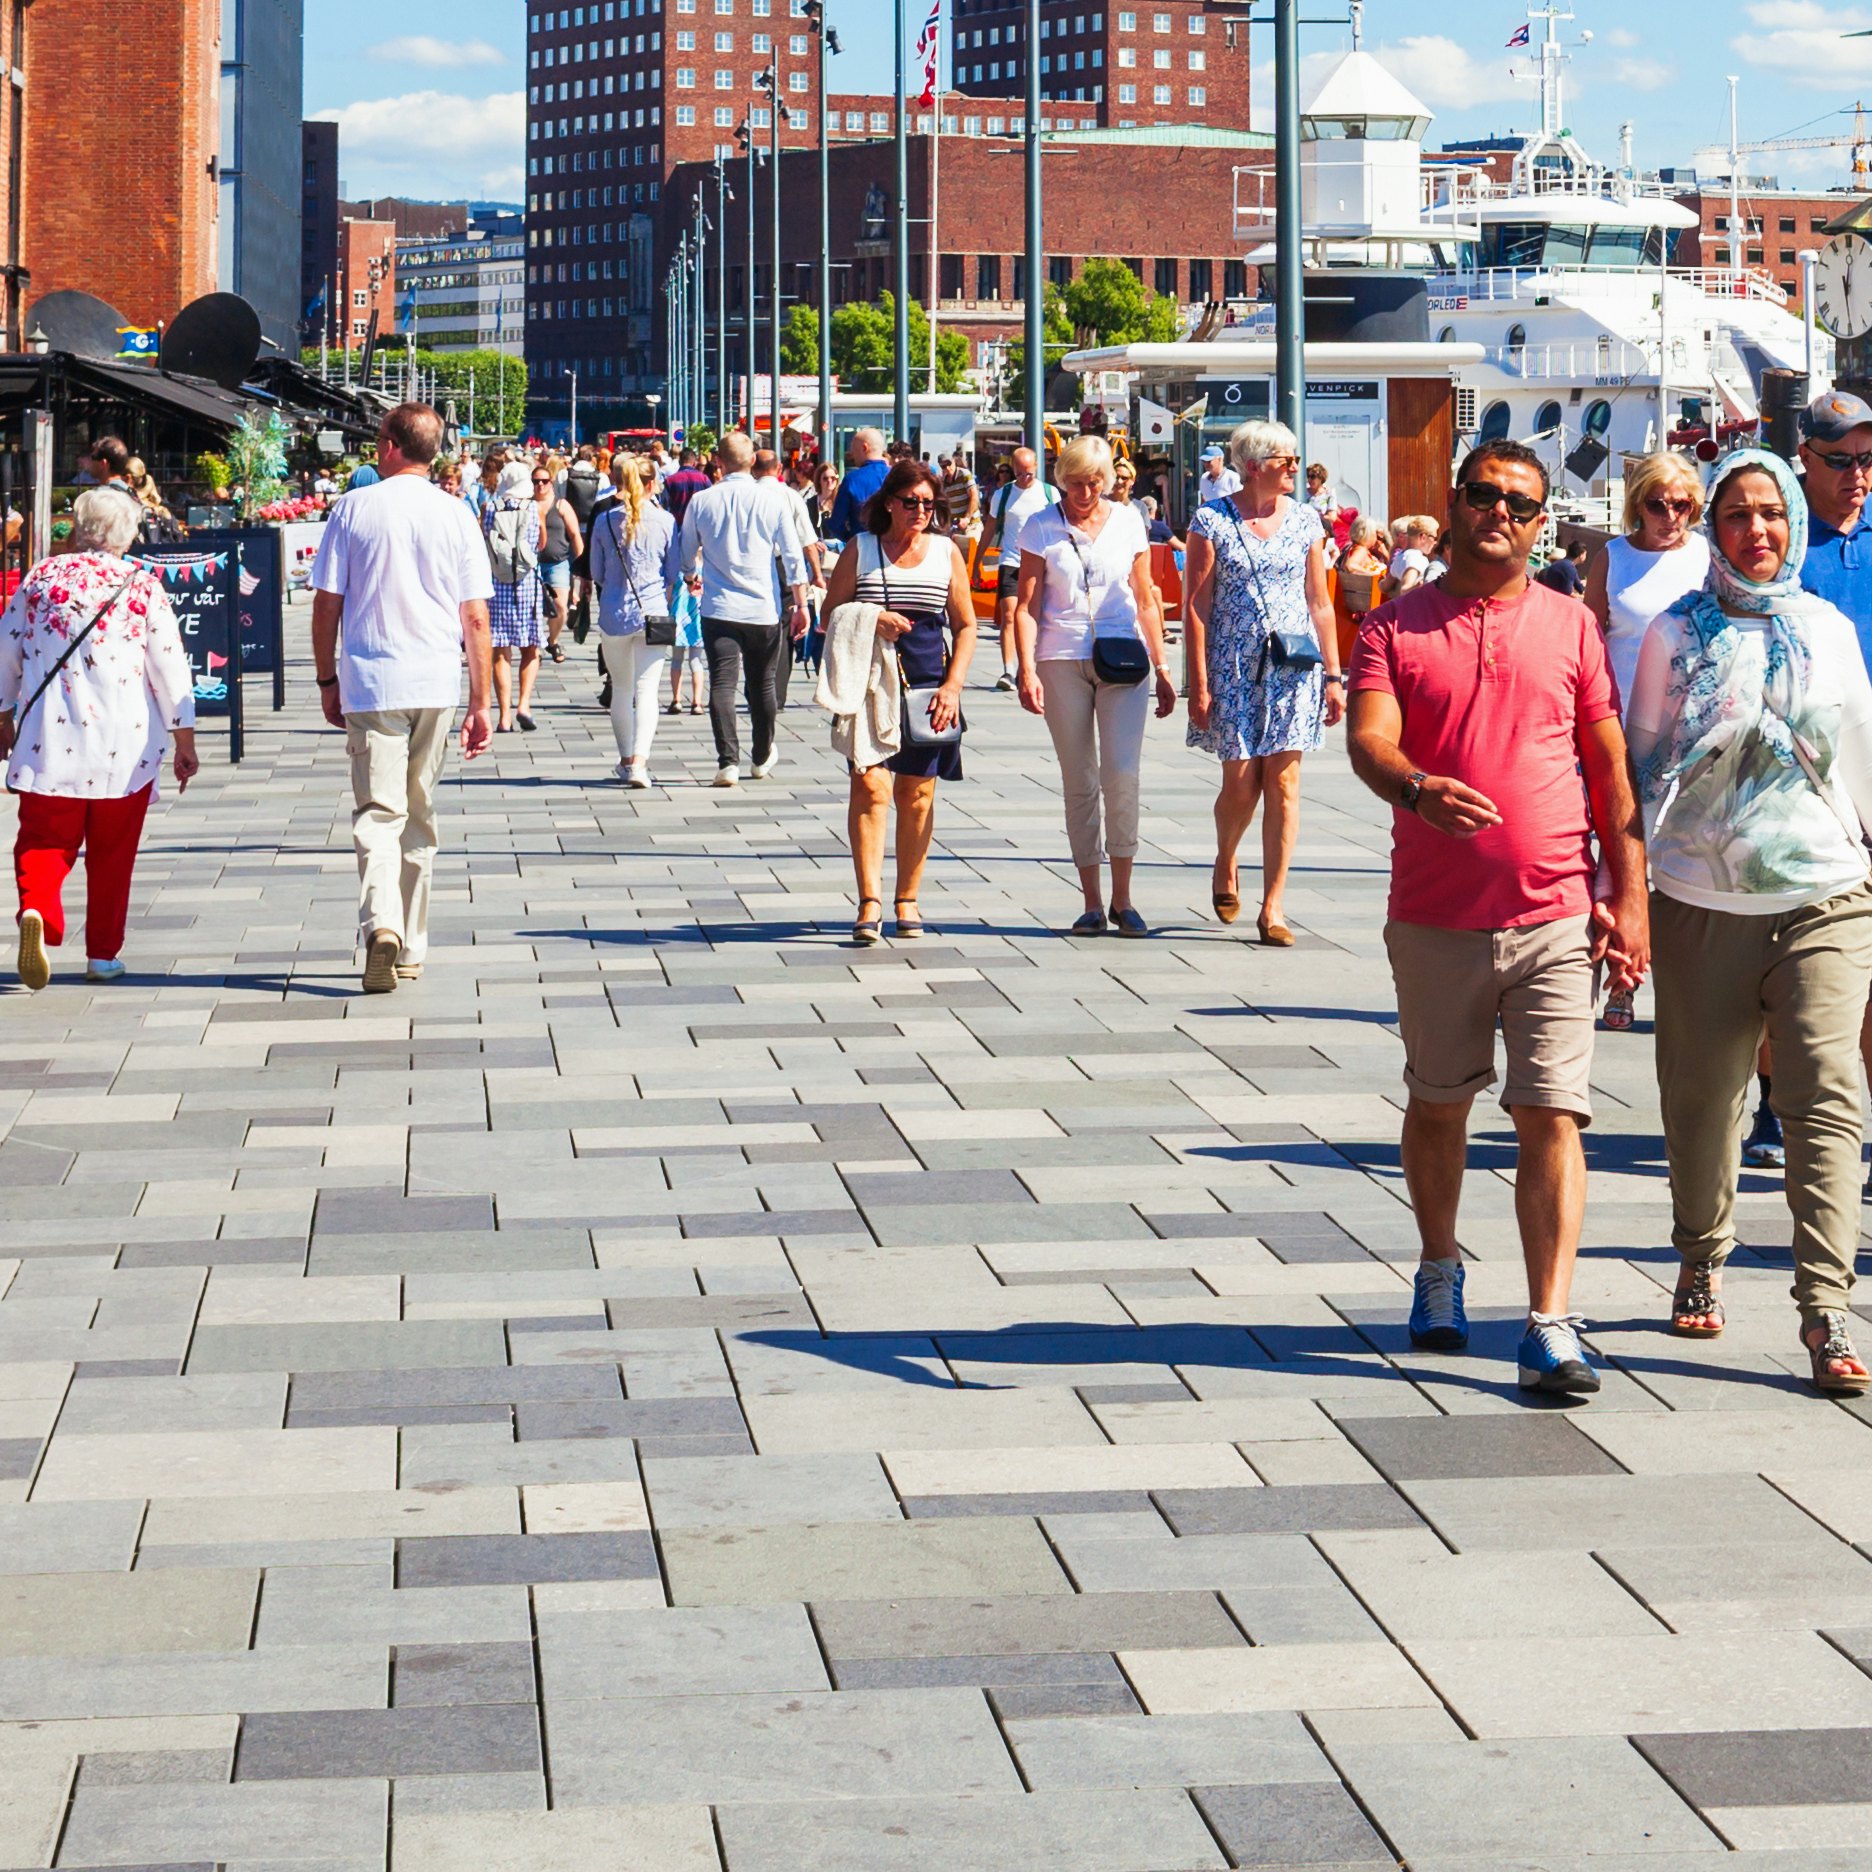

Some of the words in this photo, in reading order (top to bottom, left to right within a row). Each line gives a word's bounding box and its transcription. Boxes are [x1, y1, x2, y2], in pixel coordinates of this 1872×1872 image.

[1427, 297, 1456, 311] ORLED
[1254, 324, 1276, 336] NORL
[1304, 384, 1365, 393] VENPICK
[193, 585, 226, 606] vår
